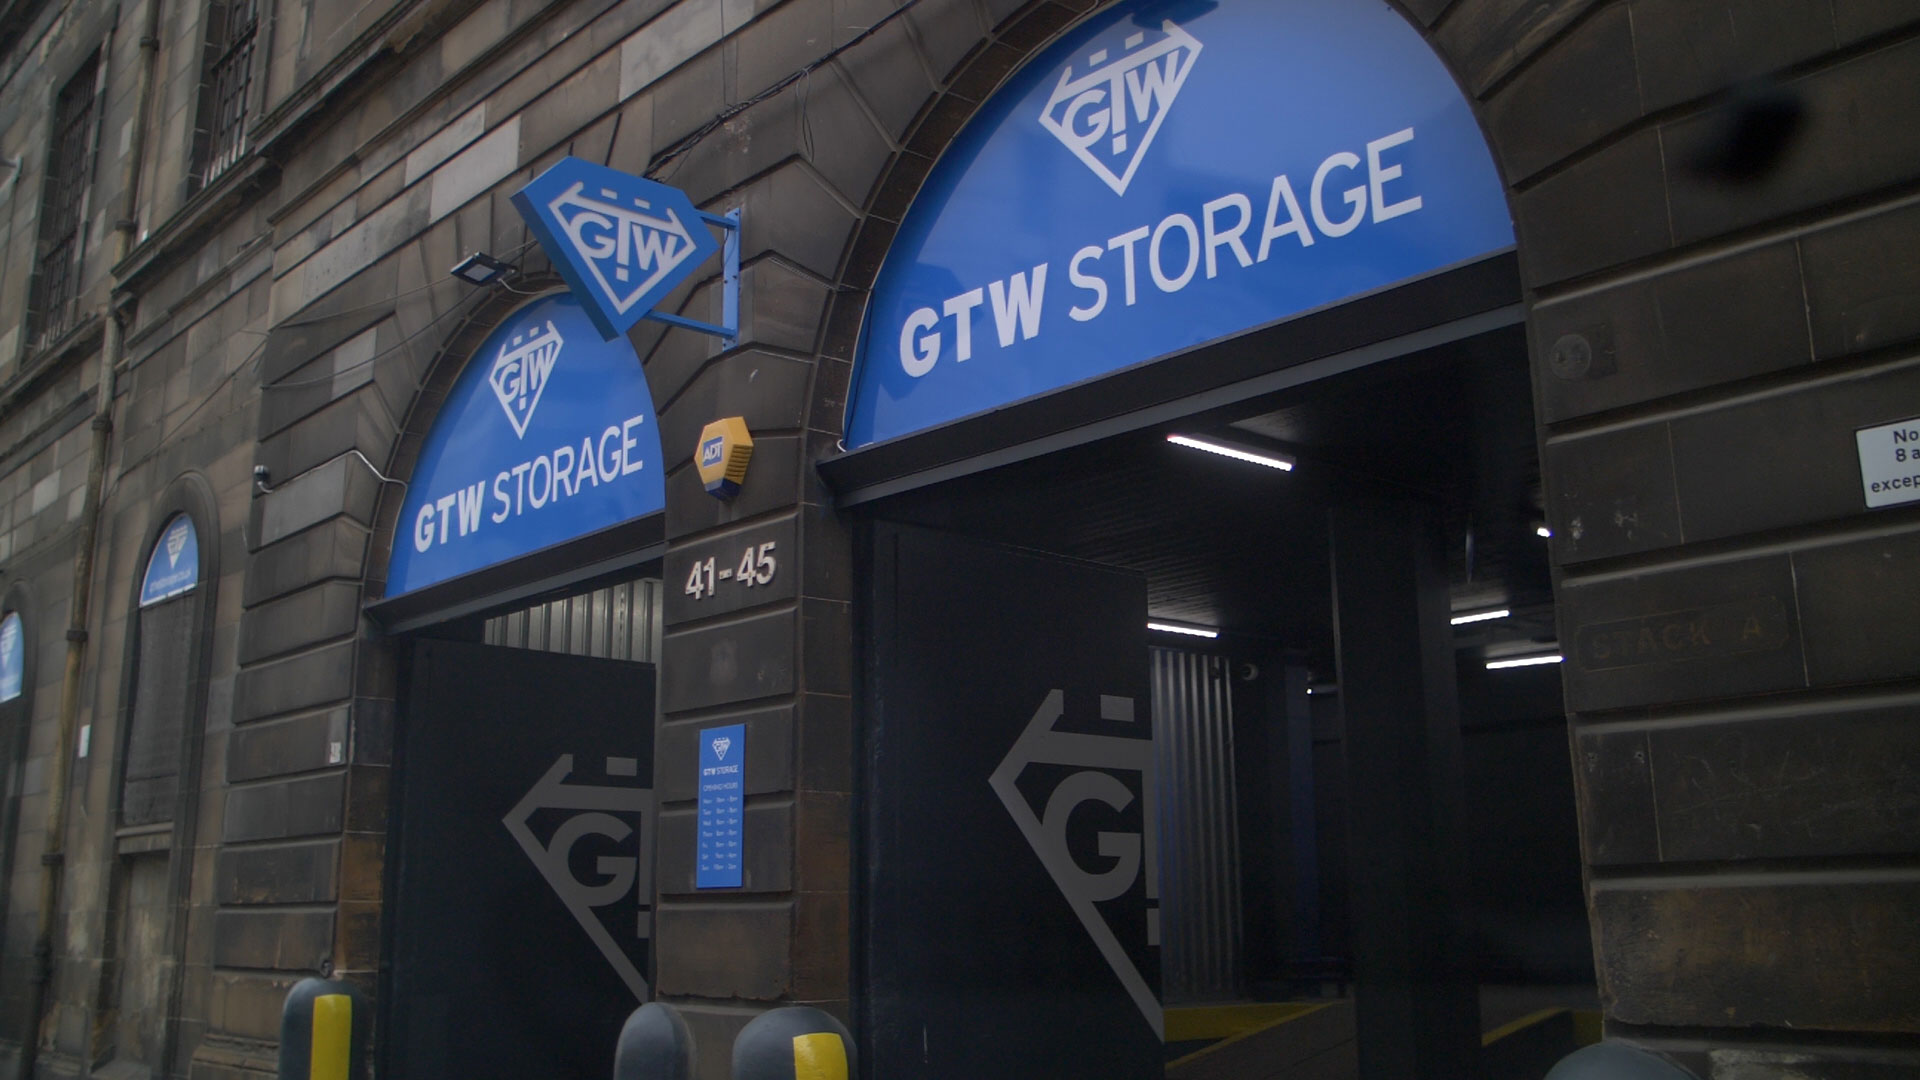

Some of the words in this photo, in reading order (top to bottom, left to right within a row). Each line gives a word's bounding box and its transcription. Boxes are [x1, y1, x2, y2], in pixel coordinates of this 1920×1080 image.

[1062, 48, 1178, 147] GTW
[899, 262, 1048, 378] GTW
[1068, 127, 1423, 322] STORAGE
[703, 441, 723, 461] ADT
[1892, 429, 1919, 444] No
[1895, 448, 1907, 462] 8
[414, 480, 486, 553] GTW
[491, 414, 644, 524] STORAGE
